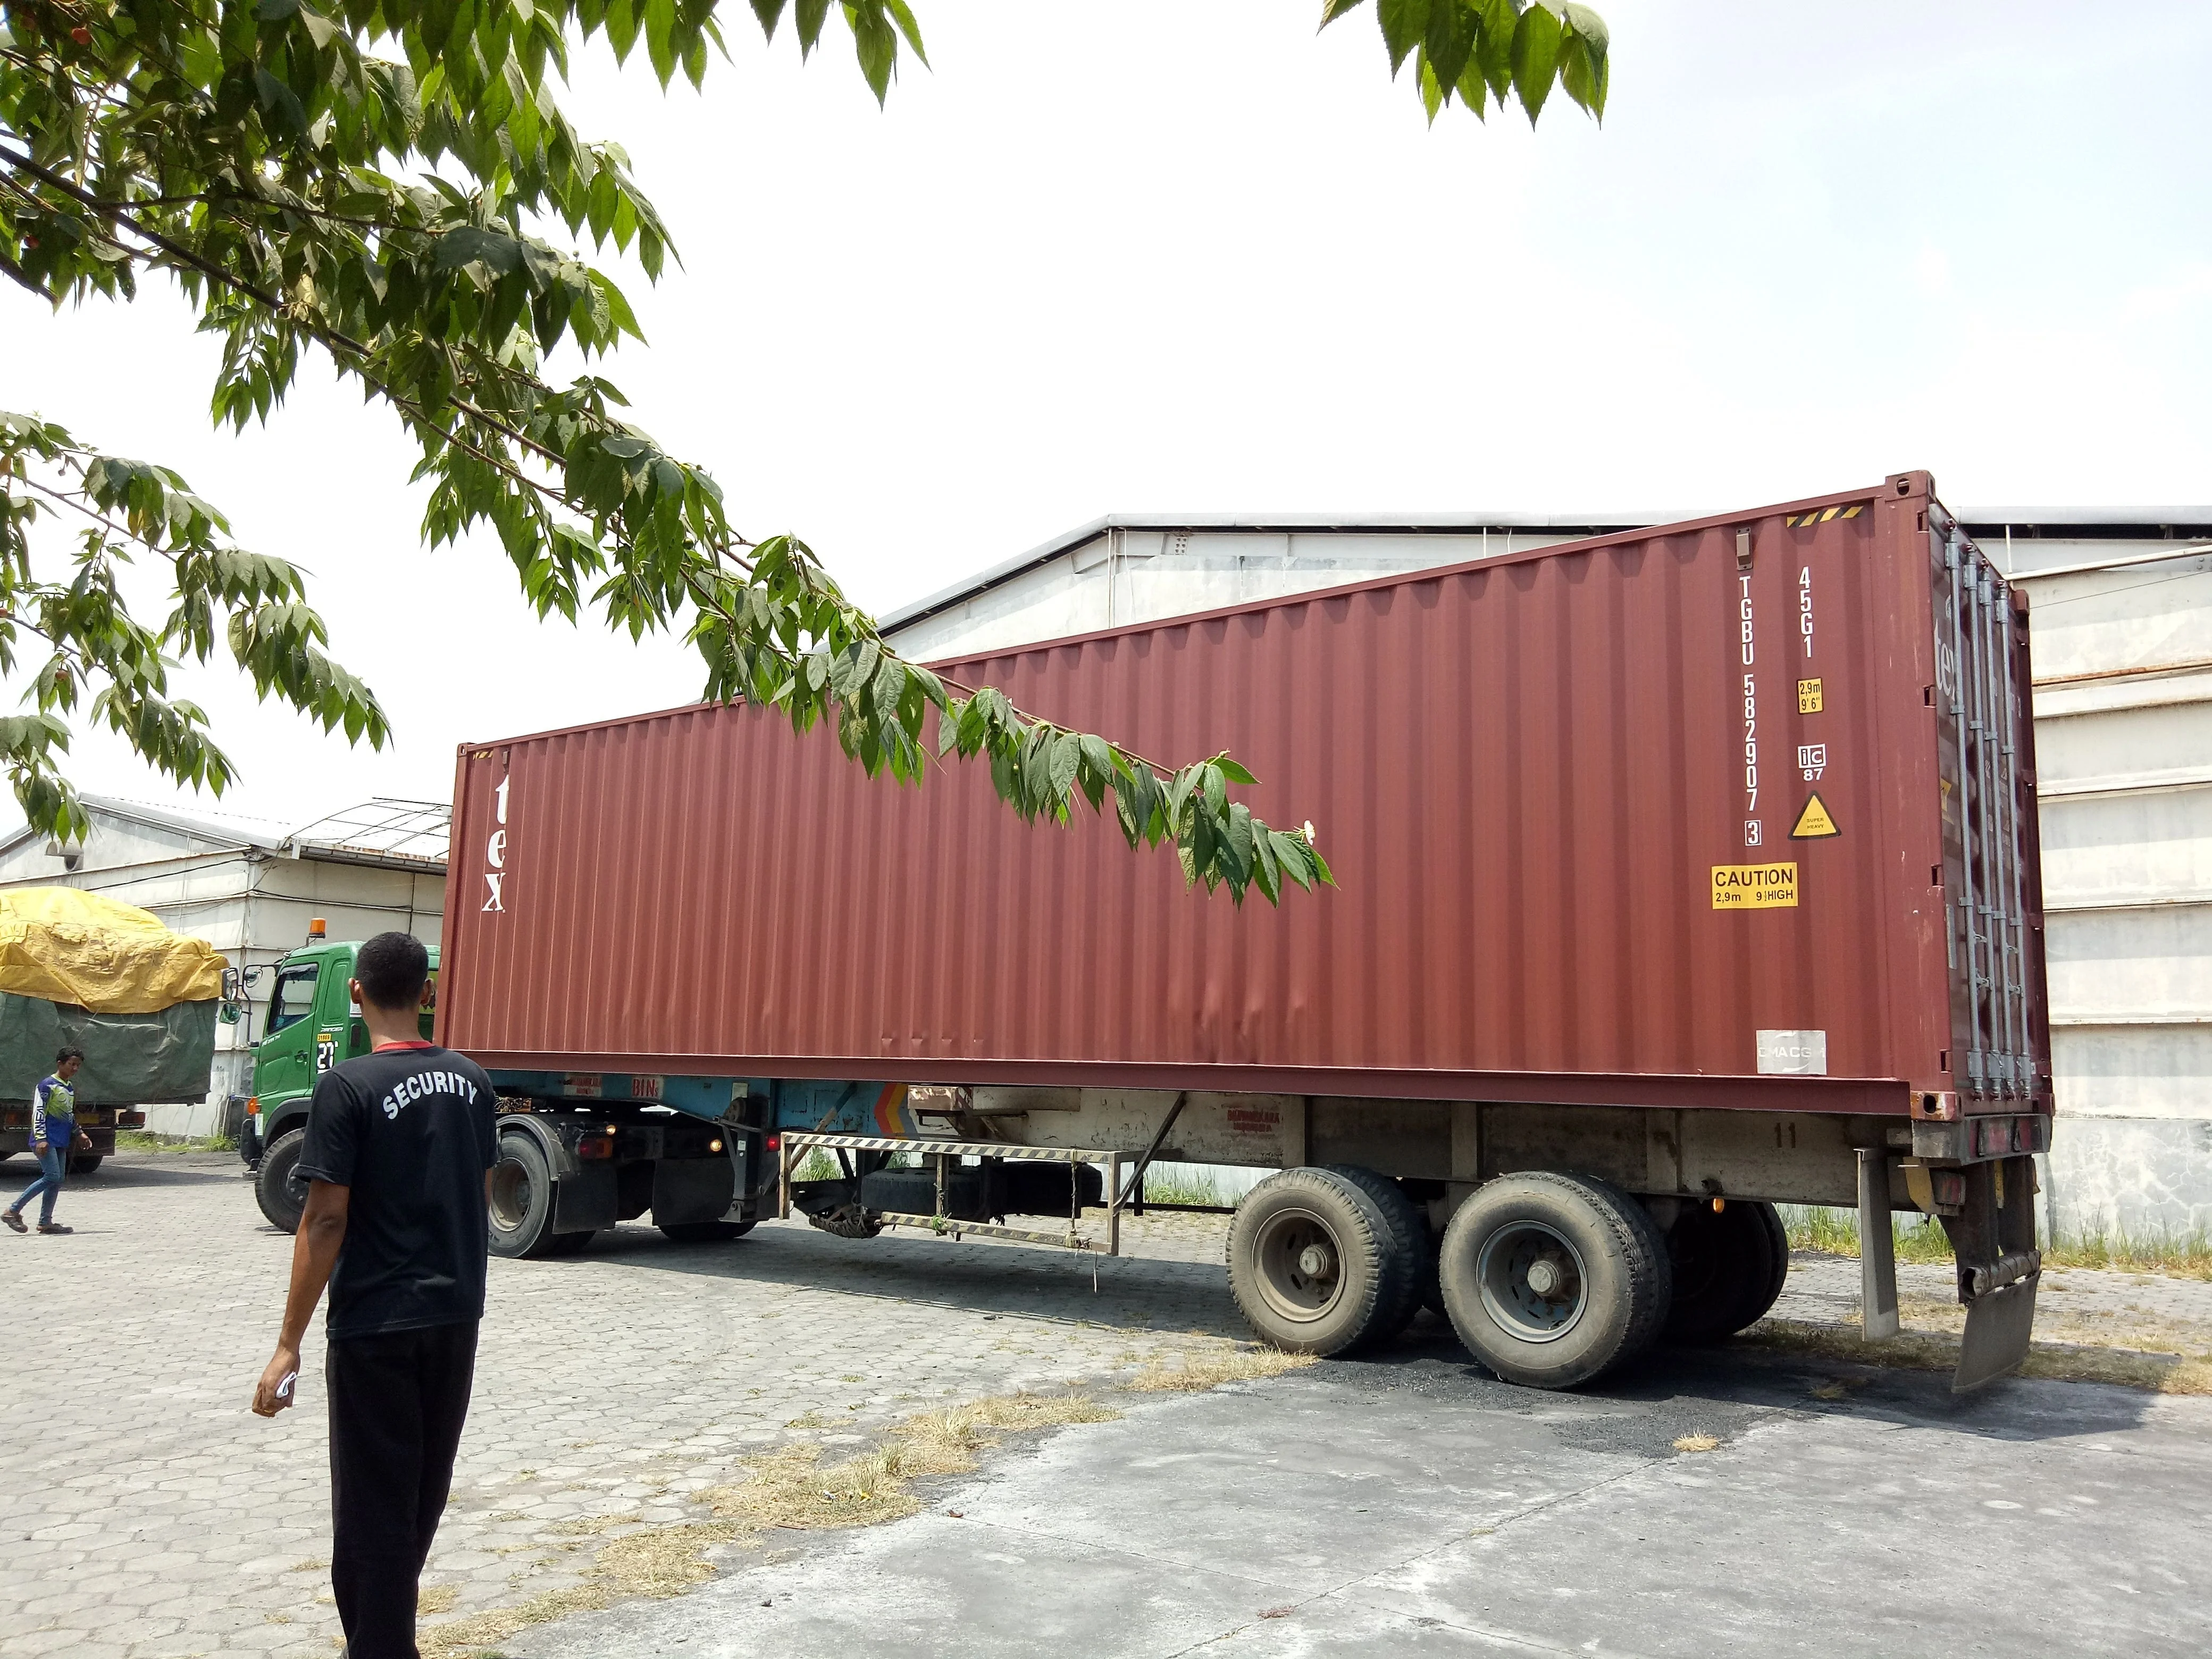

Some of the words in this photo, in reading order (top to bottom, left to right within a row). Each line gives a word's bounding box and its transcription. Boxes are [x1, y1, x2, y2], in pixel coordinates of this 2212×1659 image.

[1739, 575, 1754, 665] TGBU
[1799, 566, 1813, 658] 45G1
[1799, 682, 1821, 697] 2,9m
[1744, 674, 1757, 811] 582907
[1803, 768, 1824, 781] 87
[481, 774, 510, 912] tex
[1747, 821, 1759, 845] 3
[1715, 868, 1793, 887] CAUTION
[1715, 892, 1741, 903] 2,9m
[382, 1071, 478, 1120] SECURITY
